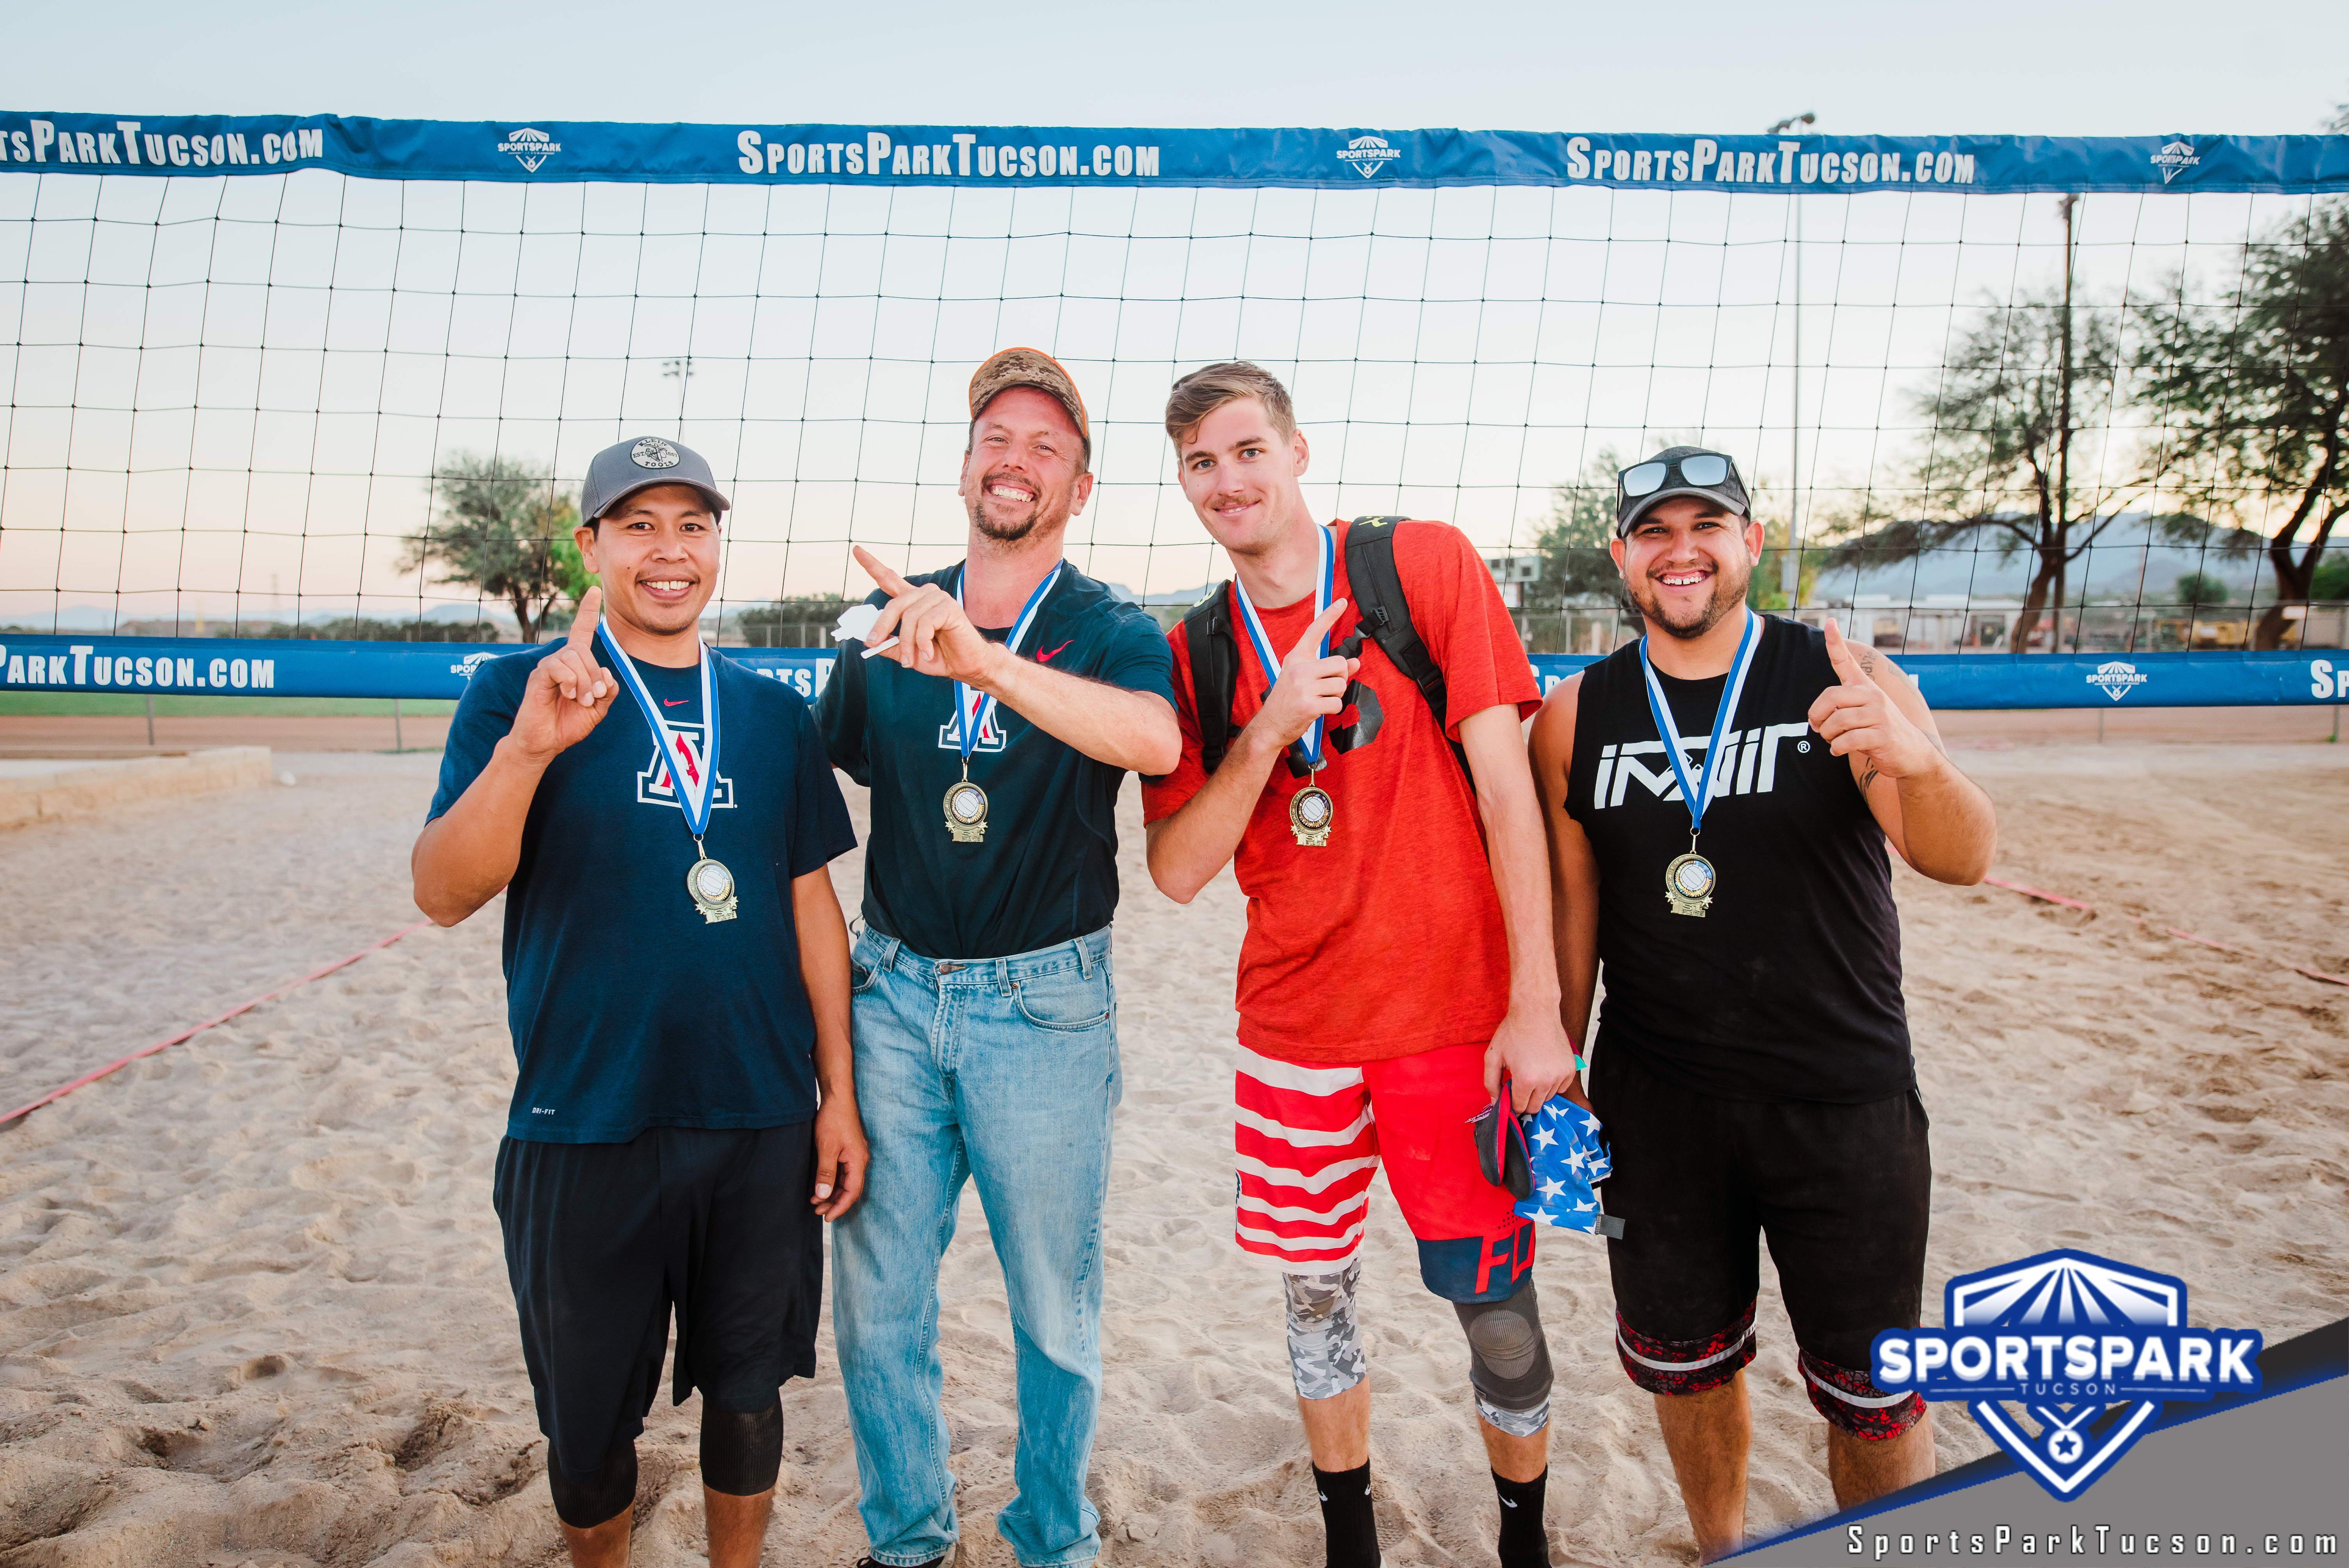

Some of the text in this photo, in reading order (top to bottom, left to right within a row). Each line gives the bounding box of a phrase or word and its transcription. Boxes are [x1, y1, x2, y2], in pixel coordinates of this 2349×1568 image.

[497, 142, 561, 152] SPORTSPARK
[1336, 148, 1401, 159] SPORTSPARK
[638, 438, 667, 447] KLEIN
[2086, 674, 2148, 683] SPORTSPARK
